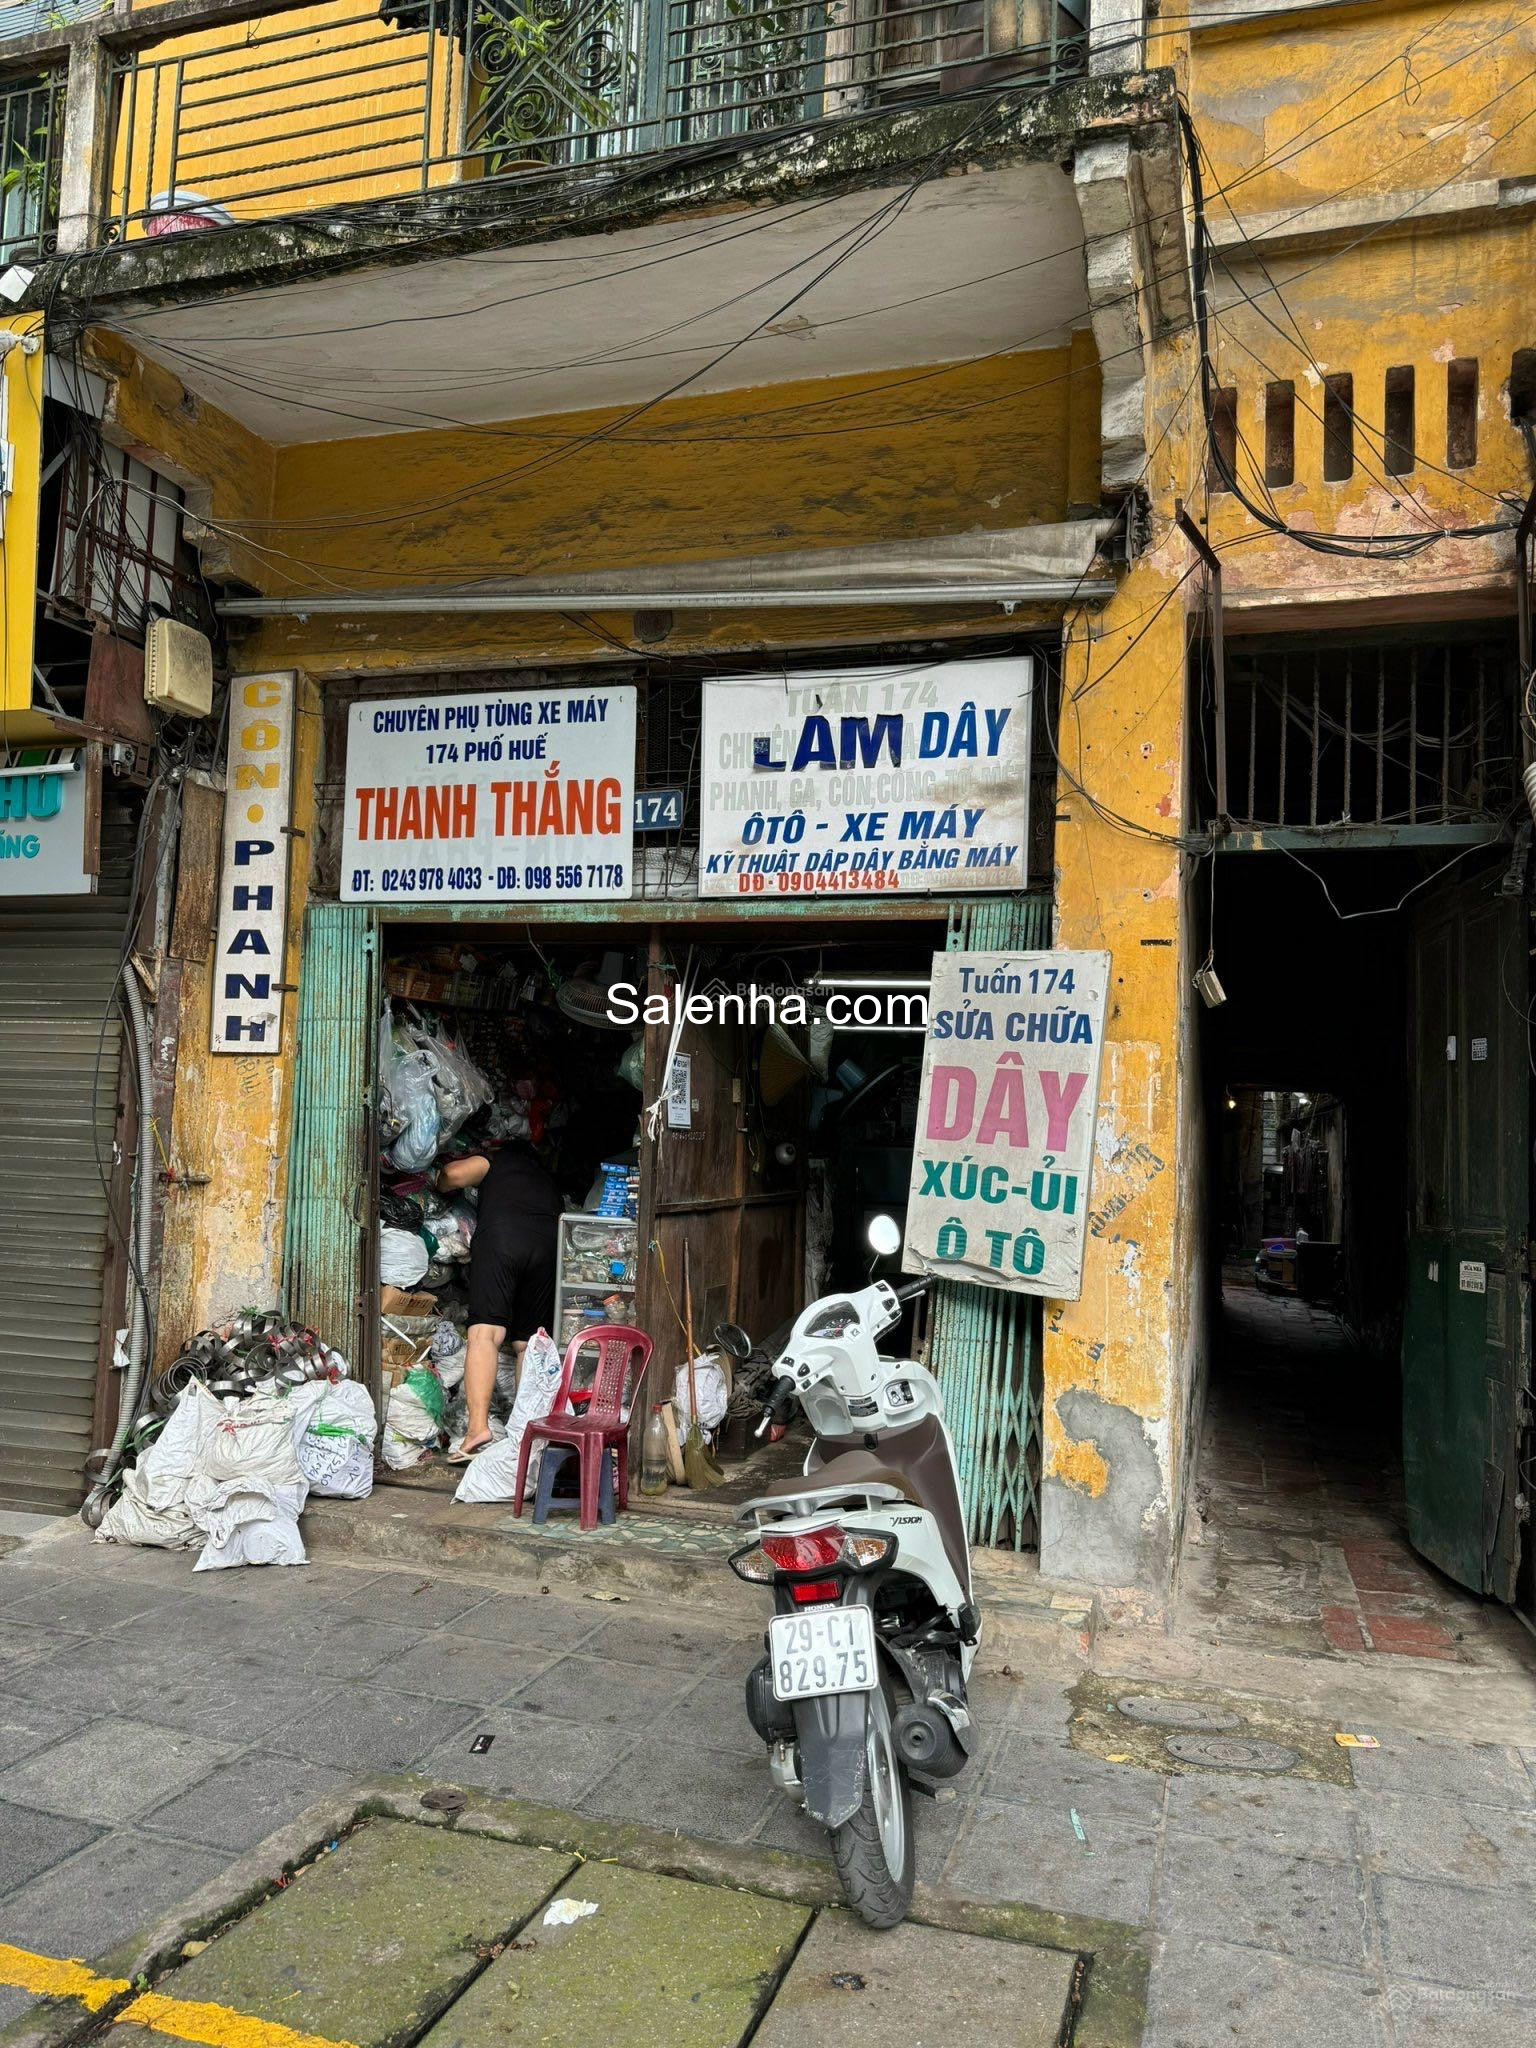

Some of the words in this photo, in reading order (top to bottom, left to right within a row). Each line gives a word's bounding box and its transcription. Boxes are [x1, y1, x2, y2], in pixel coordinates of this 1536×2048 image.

[373, 708, 440, 733] CHUYÊN
[448, 707, 478, 731] PHỤ
[485, 699, 532, 726] TÙNG
[538, 701, 561, 724] XE
[567, 695, 609, 722] MÁY
[881, 681, 938, 712] 174
[426, 744, 459, 763] 174
[465, 734, 503, 761] PHỐ
[509, 731, 548, 760] HUẾ
[919, 701, 1012, 759] DÂY
[356, 784, 477, 840] THANH
[491, 760, 622, 836] THẮNG
[635, 798, 677, 823] 174
[741, 809, 806, 845] ÔTÔ
[840, 812, 889, 842] XE
[898, 804, 986, 840] MÁY
[851, 847, 894, 871] DÂY
[899, 840, 960, 869] BẰNG
[964, 843, 1019, 867] MÁY
[352, 869, 374, 892] ĐT:
[382, 870, 415, 891] 0243
[419, 869, 443, 890] 978
[448, 867, 482, 889] 4033
[525, 867, 550, 888] 098
[556, 866, 582, 888] 556
[587, 864, 623, 887] 7178
[778, 870, 899, 890] 0904413484
[226, 839, 275, 1042] PHANH
[959, 963, 1021, 995] Tuấn
[1029, 968, 1075, 995] 174
[934, 999, 994, 1041] SỬA
[1005, 1006, 1093, 1044] CHỮA
[926, 1051, 1089, 1152] DÂY
[918, 1155, 1078, 1214] XÚC-ỦI
[936, 1216, 968, 1259] Ô
[984, 1227, 1045, 1275] TÔ
[804, 1603, 835, 1613] HONDA
[784, 1615, 855, 1654] 29-C1
[779, 1651, 868, 1692] 829.75
